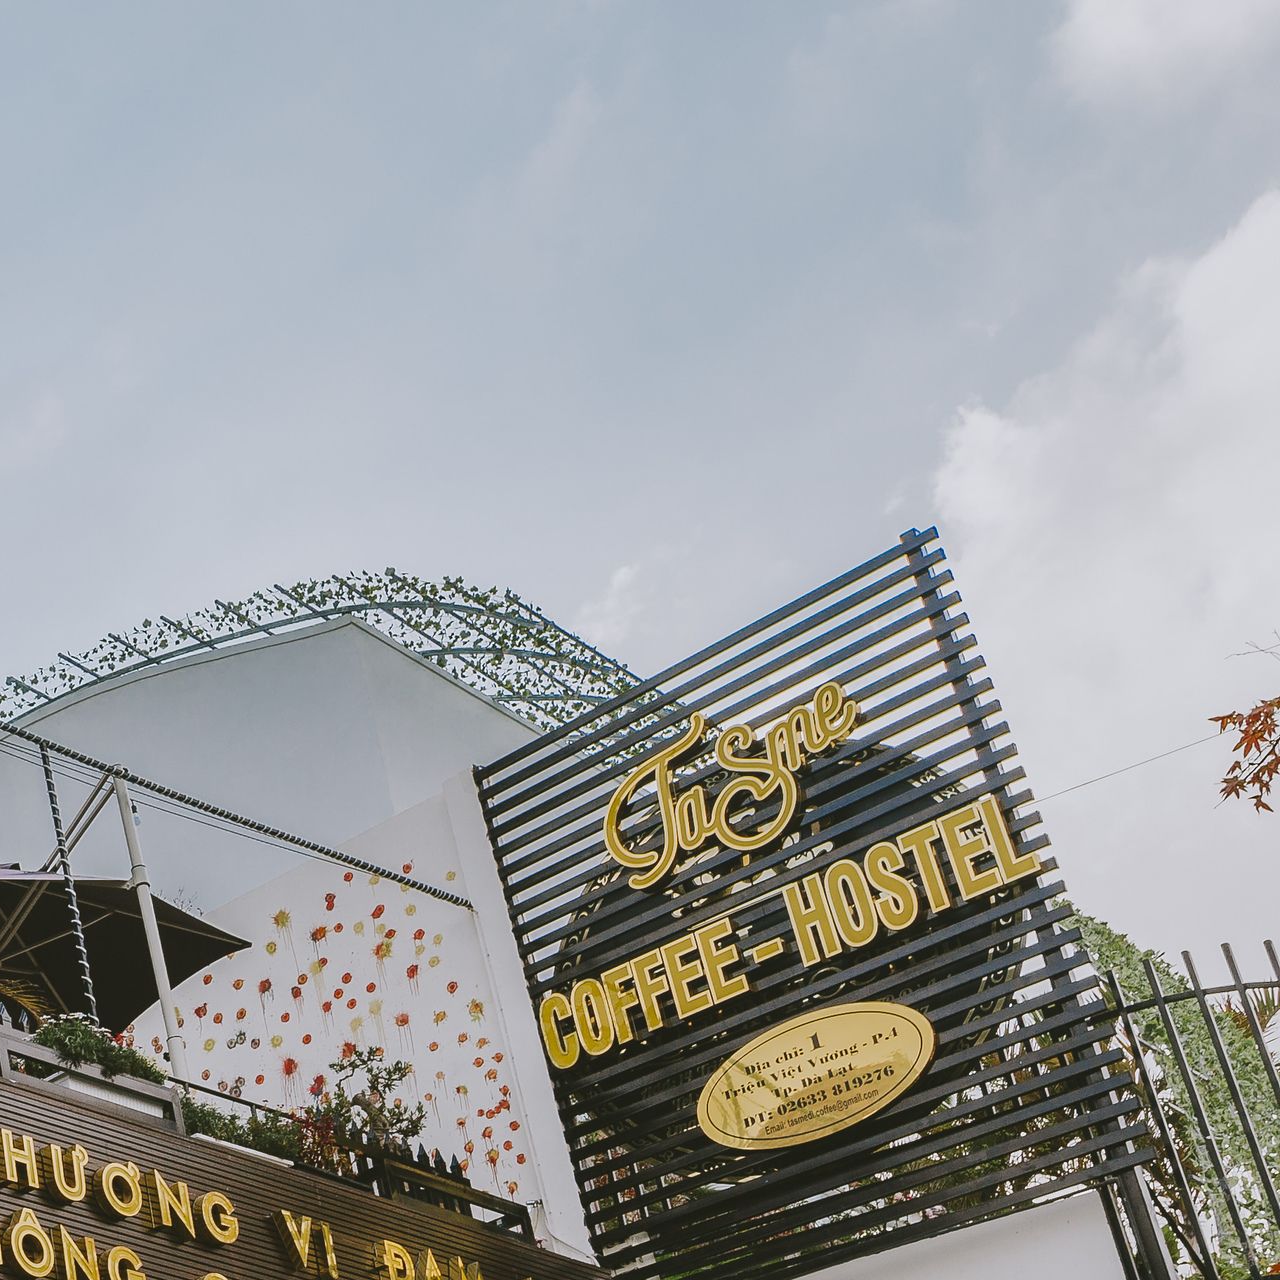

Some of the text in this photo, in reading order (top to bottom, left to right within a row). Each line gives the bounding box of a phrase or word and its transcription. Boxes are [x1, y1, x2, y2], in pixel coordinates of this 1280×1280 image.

[603, 681, 857, 889] TaSme
[539, 919, 748, 1070] COFFEE
[783, 795, 1042, 968] HOSTEL
[770, 1065, 802, 1085] Việt
[808, 1042, 859, 1068] Vương
[872, 1027, 898, 1045] P.4
[808, 1031, 825, 1051] 1
[771, 1084, 797, 1099] Tp.
[828, 1061, 856, 1079] Lạt
[777, 1089, 827, 1116] 02633
[832, 1065, 895, 1097] 819276
[765, 1120, 786, 1136] Email:
